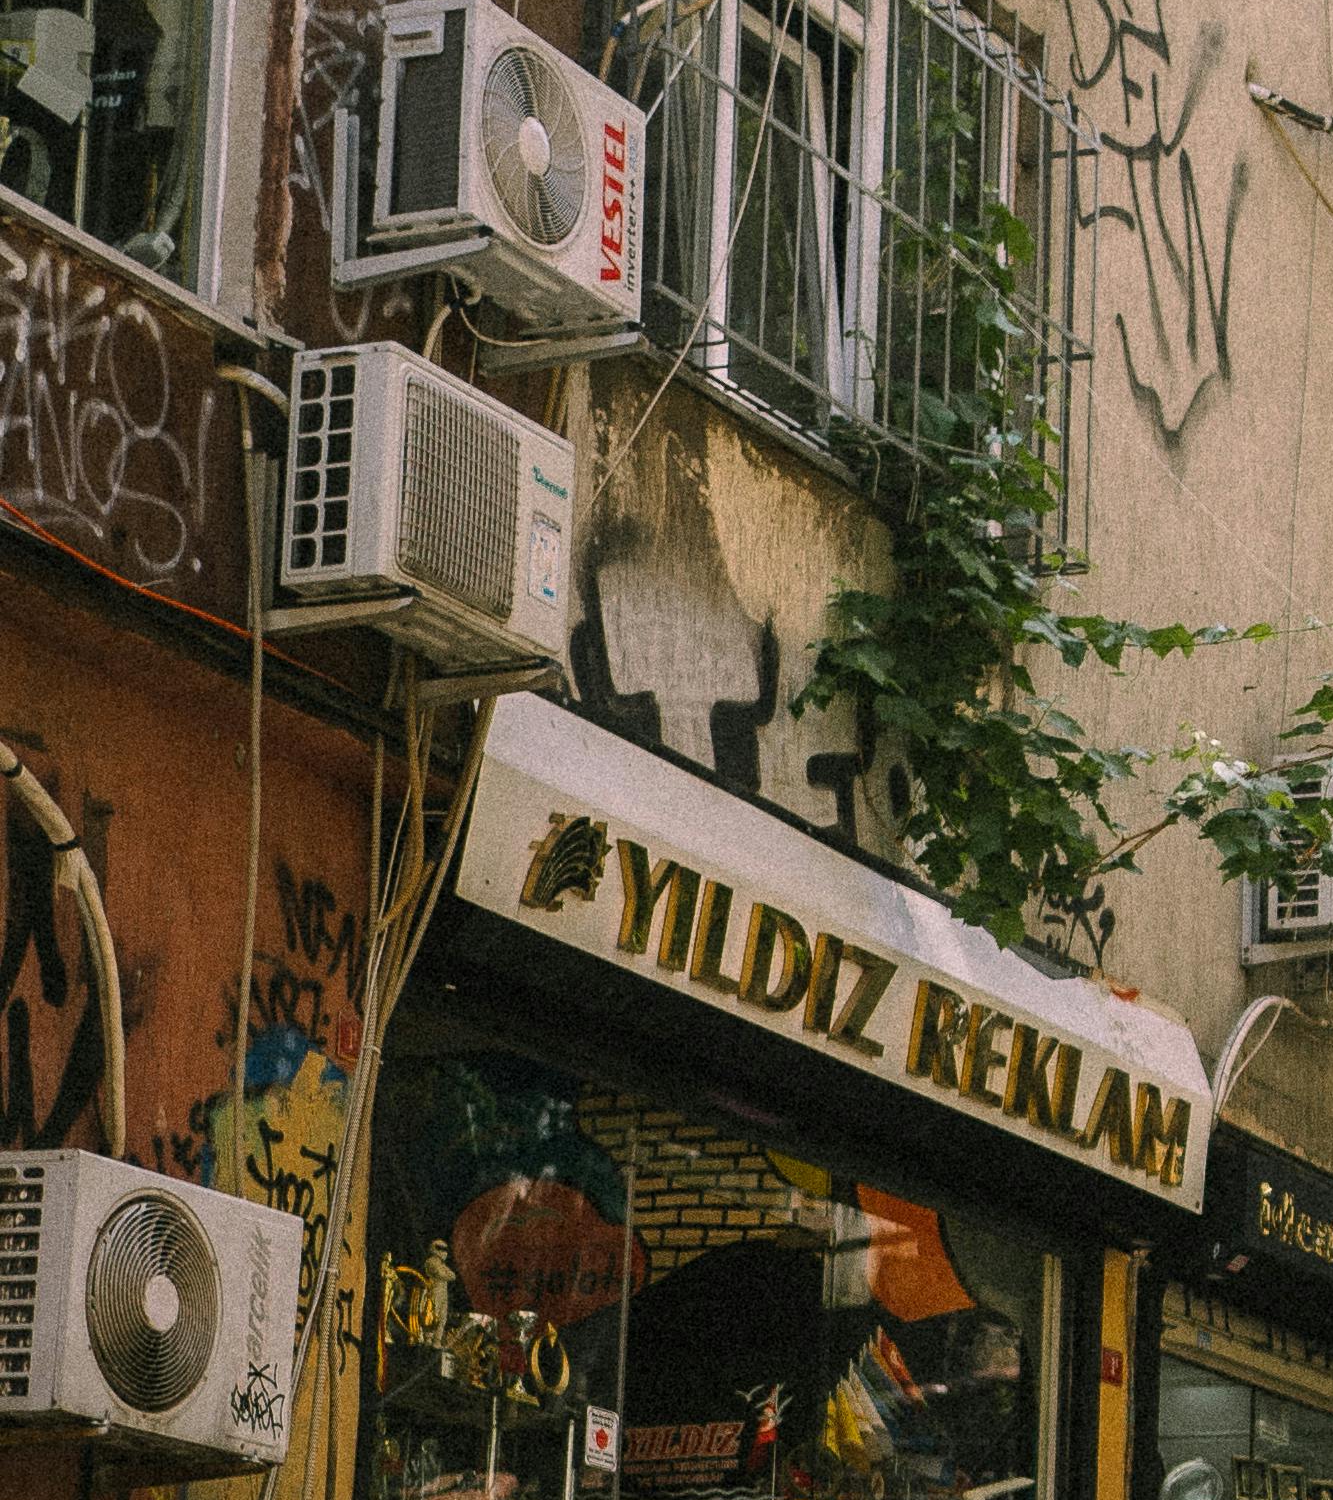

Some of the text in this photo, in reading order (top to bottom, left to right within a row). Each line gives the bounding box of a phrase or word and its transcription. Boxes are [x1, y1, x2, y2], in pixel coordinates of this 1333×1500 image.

[600, 119, 626, 281] VESTEL
[617, 838, 898, 1058] YILDIZ
[906, 980, 1191, 1187] REKLAM
[624, 1422, 745, 1461] YILDIZ
